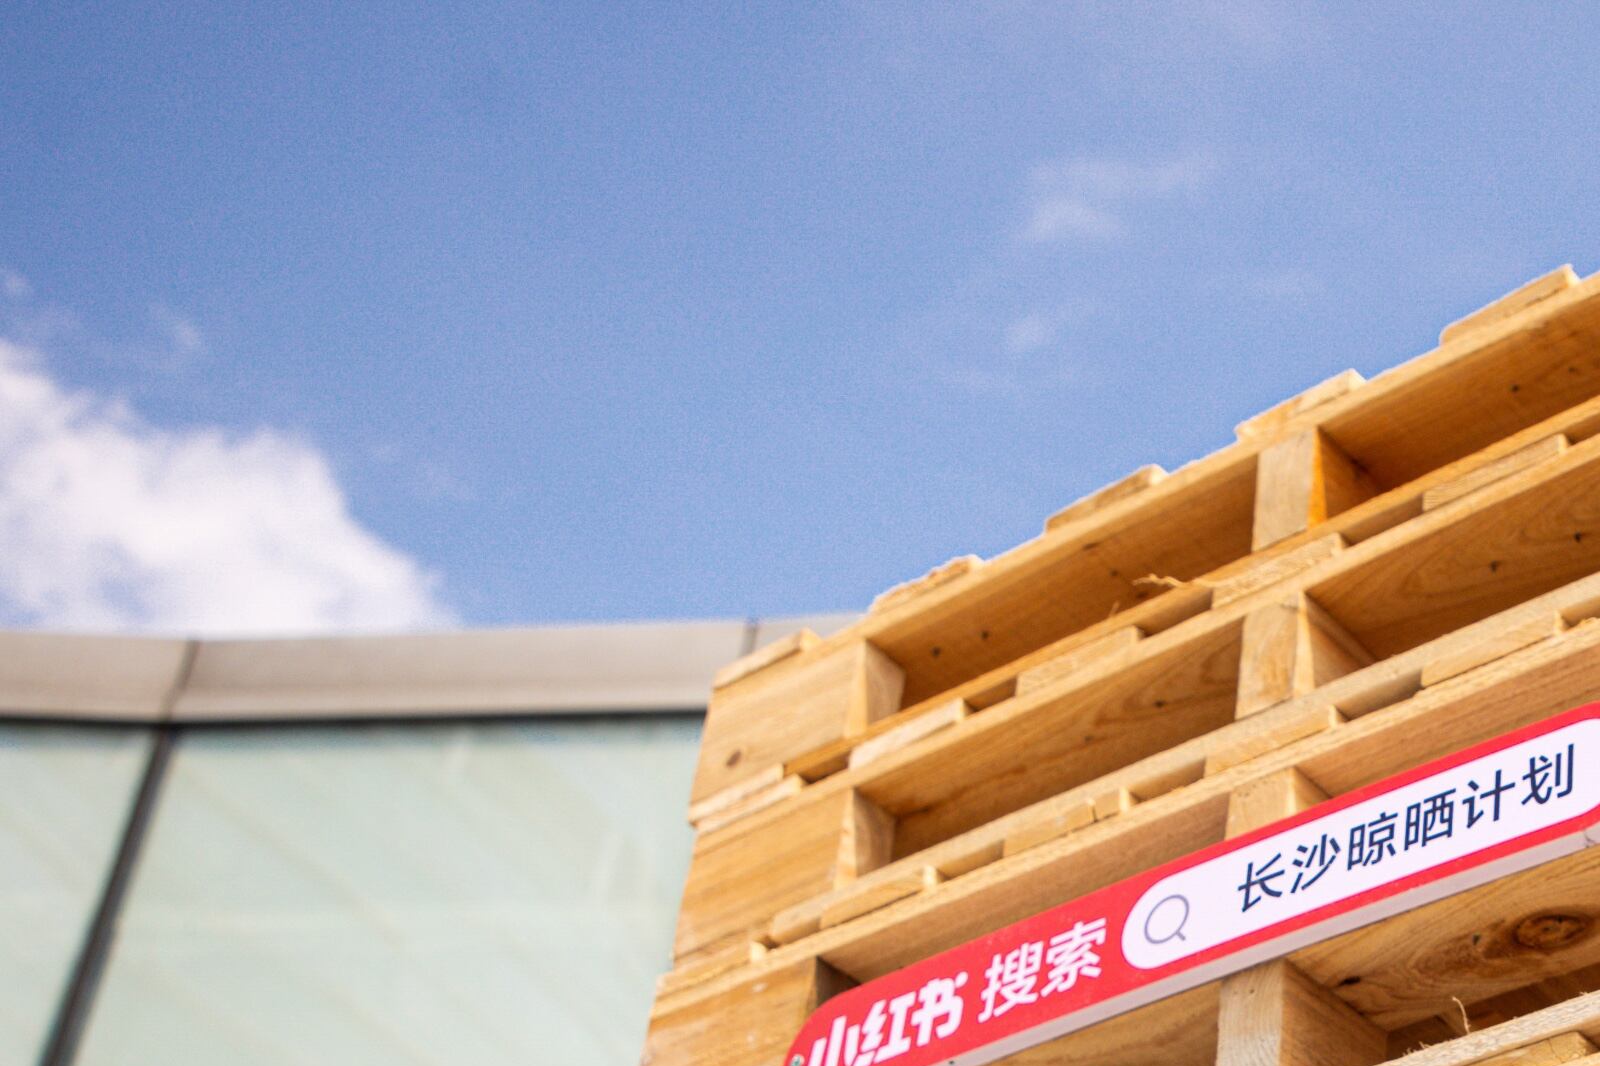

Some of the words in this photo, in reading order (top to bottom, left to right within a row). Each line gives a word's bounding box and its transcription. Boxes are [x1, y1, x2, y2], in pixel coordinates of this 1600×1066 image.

[976, 917, 1107, 1025] 搜索
[1236, 742, 1576, 914] 长沙晾晒计划
